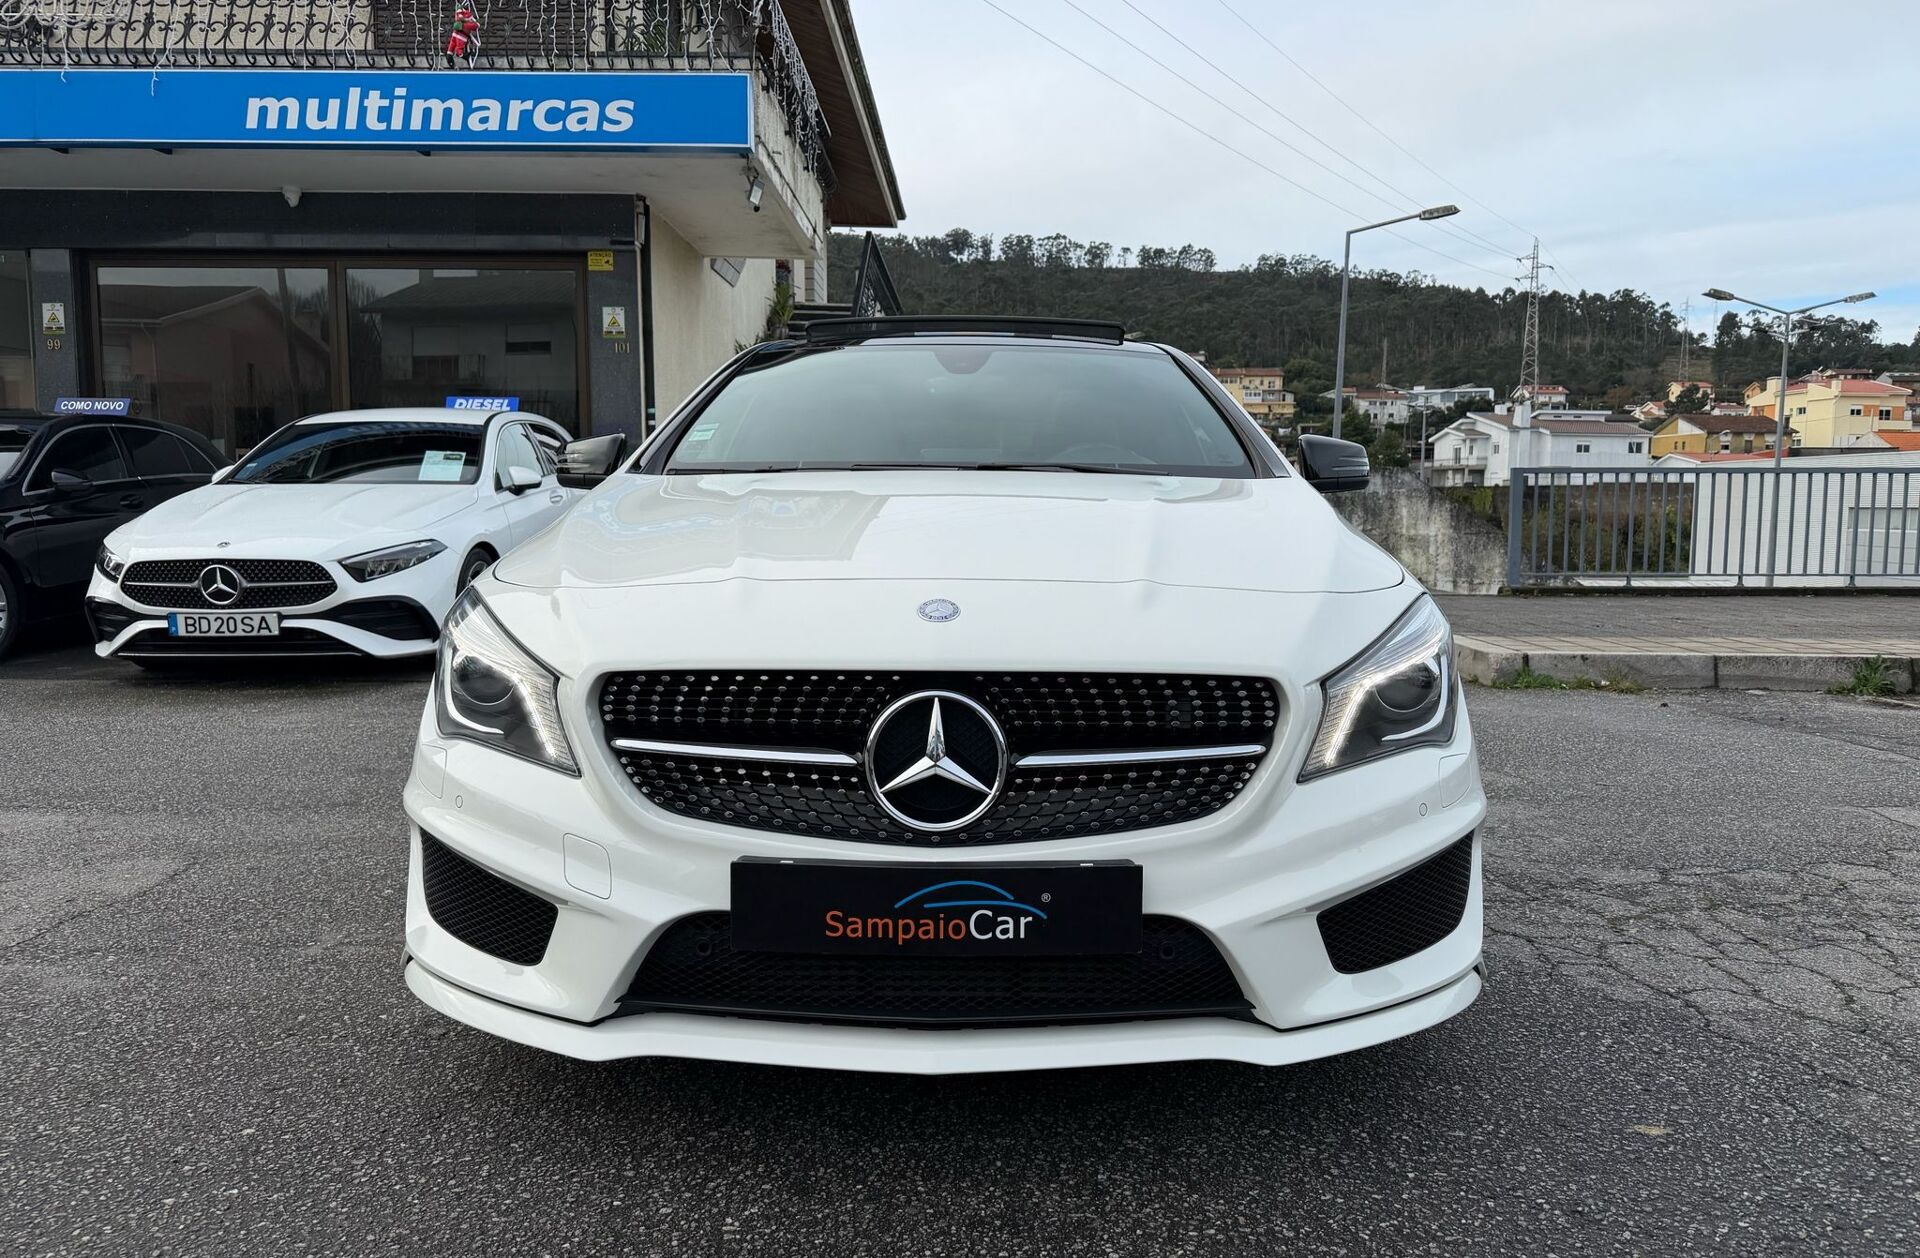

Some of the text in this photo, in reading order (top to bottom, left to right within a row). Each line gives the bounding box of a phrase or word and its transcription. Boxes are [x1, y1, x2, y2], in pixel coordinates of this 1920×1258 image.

[245, 86, 635, 132] multimarcas
[46, 338, 62, 350] 99
[614, 343, 630, 353] 101
[60, 401, 124, 411] COMO NOVO
[454, 398, 511, 411] DIESEL
[825, 909, 1033, 945] SampaioCar
